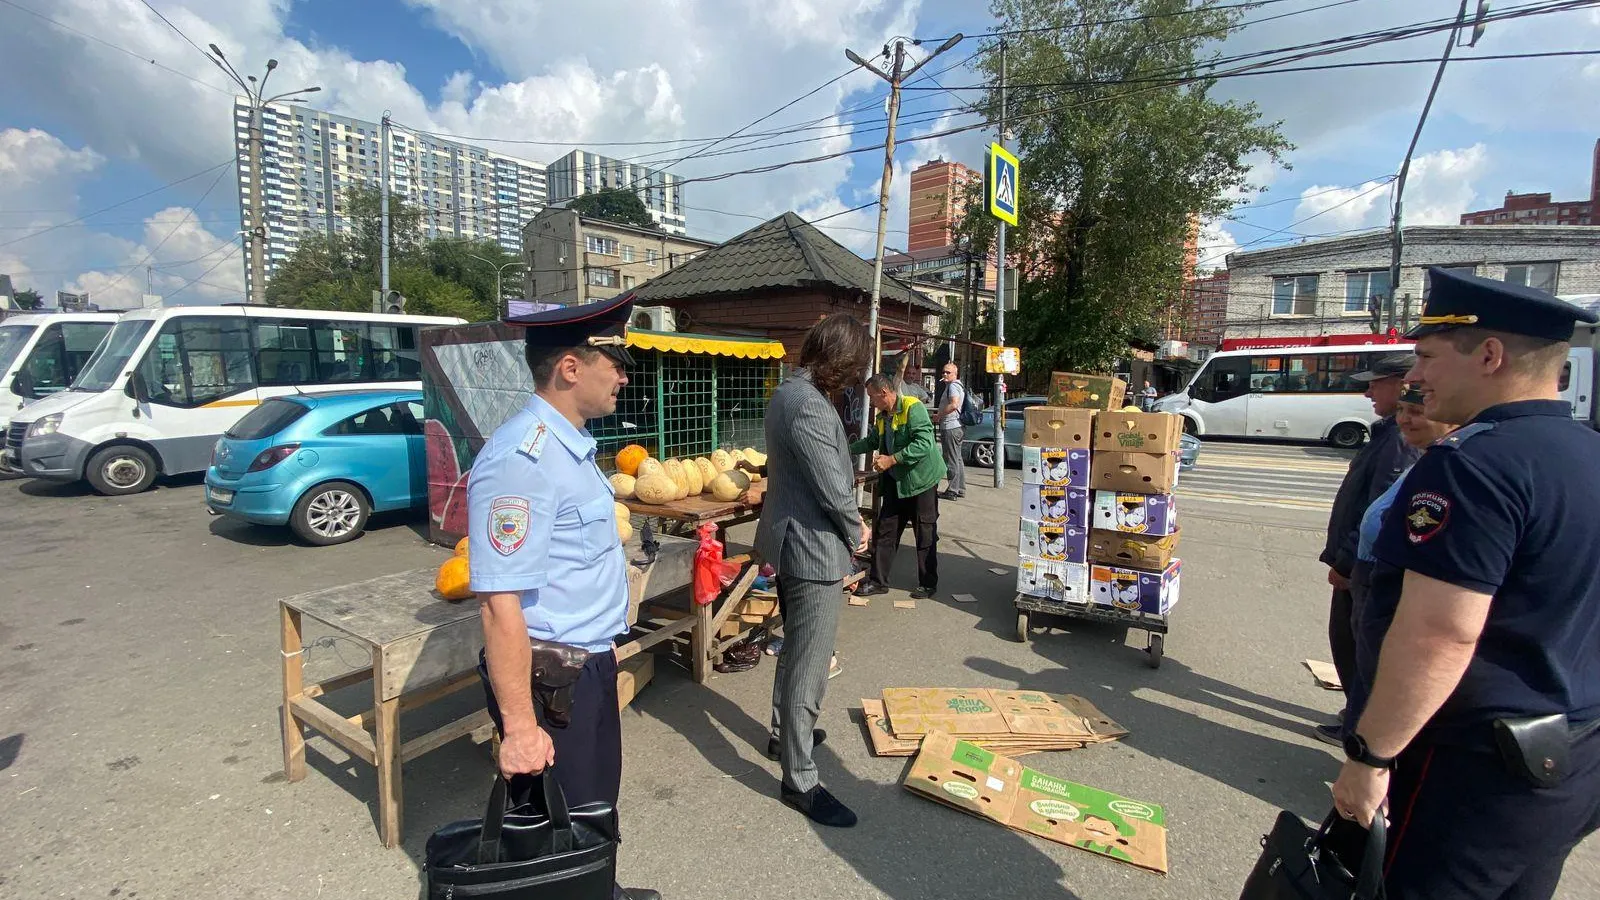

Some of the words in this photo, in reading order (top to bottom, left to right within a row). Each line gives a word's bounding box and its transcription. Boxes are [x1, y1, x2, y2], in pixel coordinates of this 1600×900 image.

[1118, 432, 1141, 441] Global
[1119, 438, 1144, 448] Village
[1032, 775, 1067, 792] БАНАНЫ
